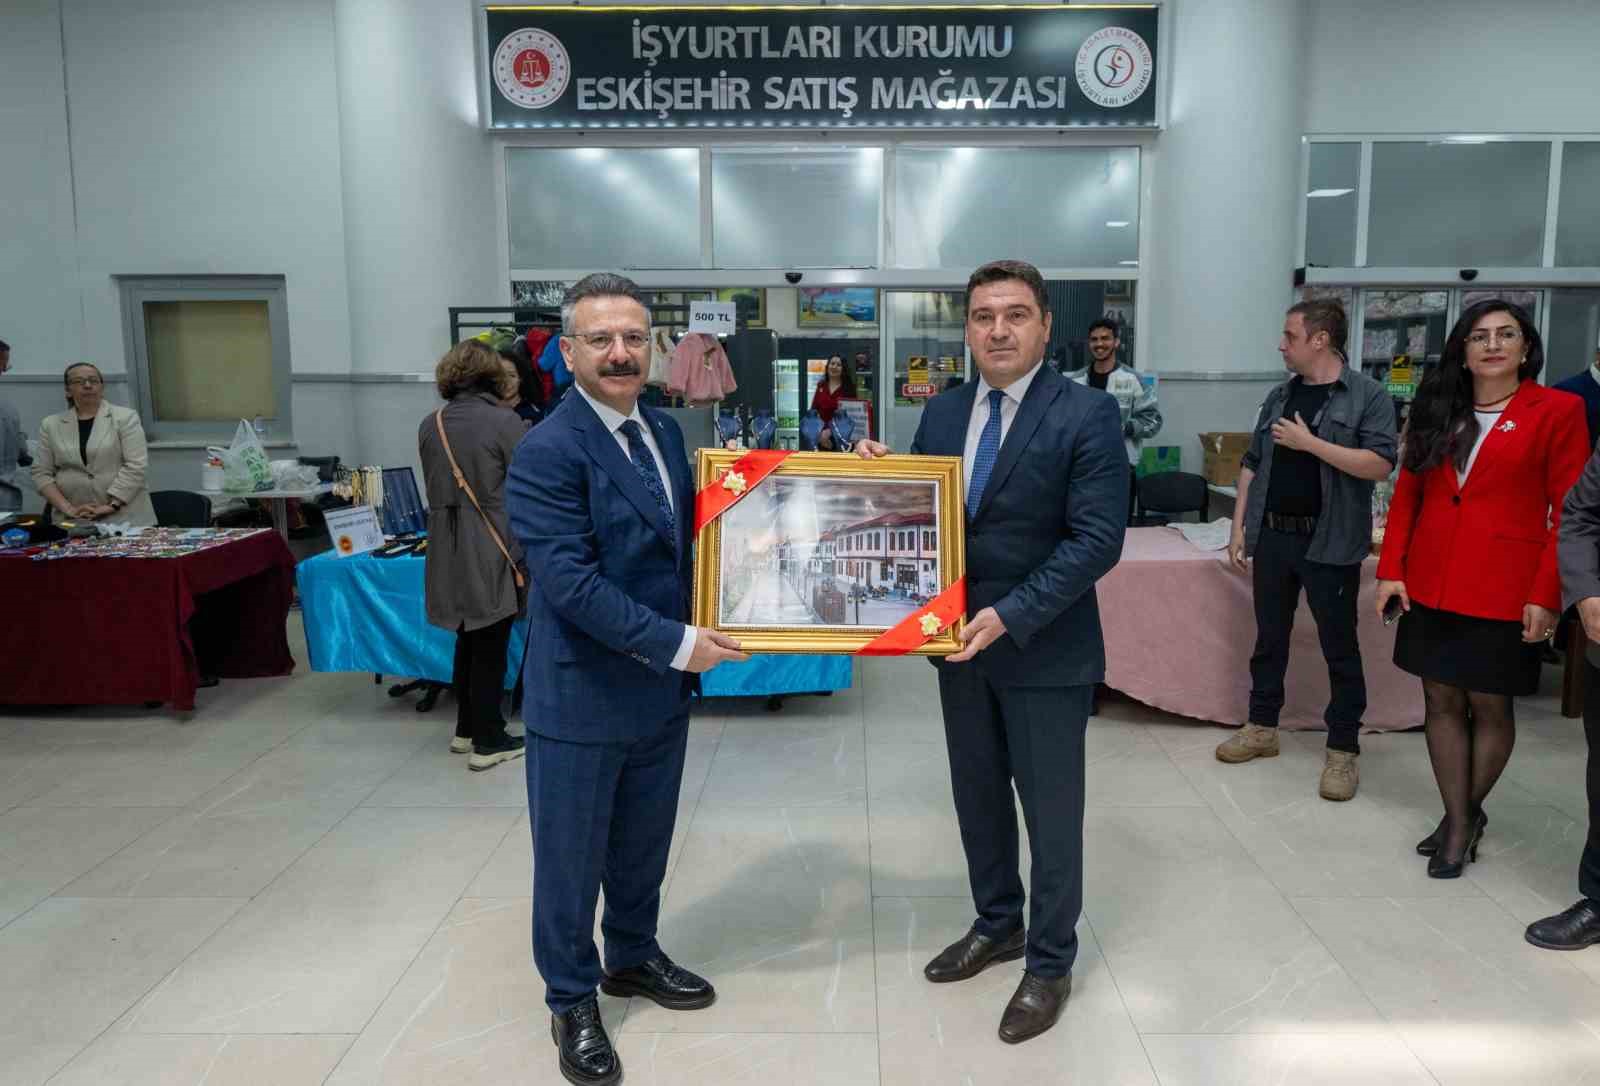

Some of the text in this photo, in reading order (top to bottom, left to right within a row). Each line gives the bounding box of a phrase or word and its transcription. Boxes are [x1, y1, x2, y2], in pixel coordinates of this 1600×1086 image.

[632, 18, 1012, 66] İŞYURTLARI KURUMU
[577, 69, 1066, 119] ESKİŞEHİR SATIŞ MAĞAZASI
[695, 312, 731, 322] 500 TL
